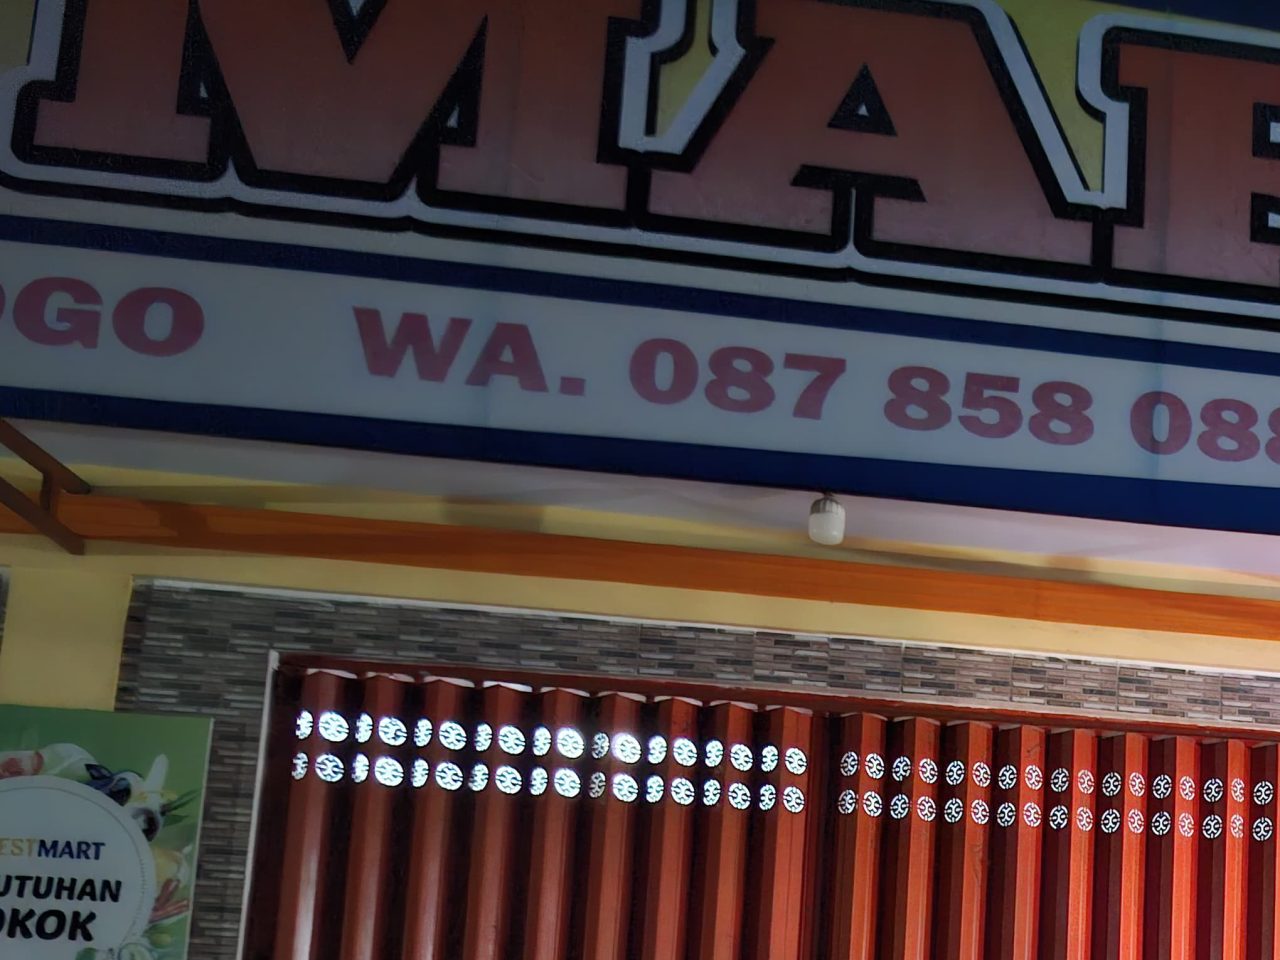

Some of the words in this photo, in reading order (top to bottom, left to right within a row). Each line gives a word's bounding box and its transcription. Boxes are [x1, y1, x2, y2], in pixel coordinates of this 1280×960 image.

[0, 276, 205, 357] GO
[354, 307, 586, 396] WA.
[629, 338, 847, 419] 087
[884, 365, 1094, 446] 858
[0, 908, 96, 941] KOK
